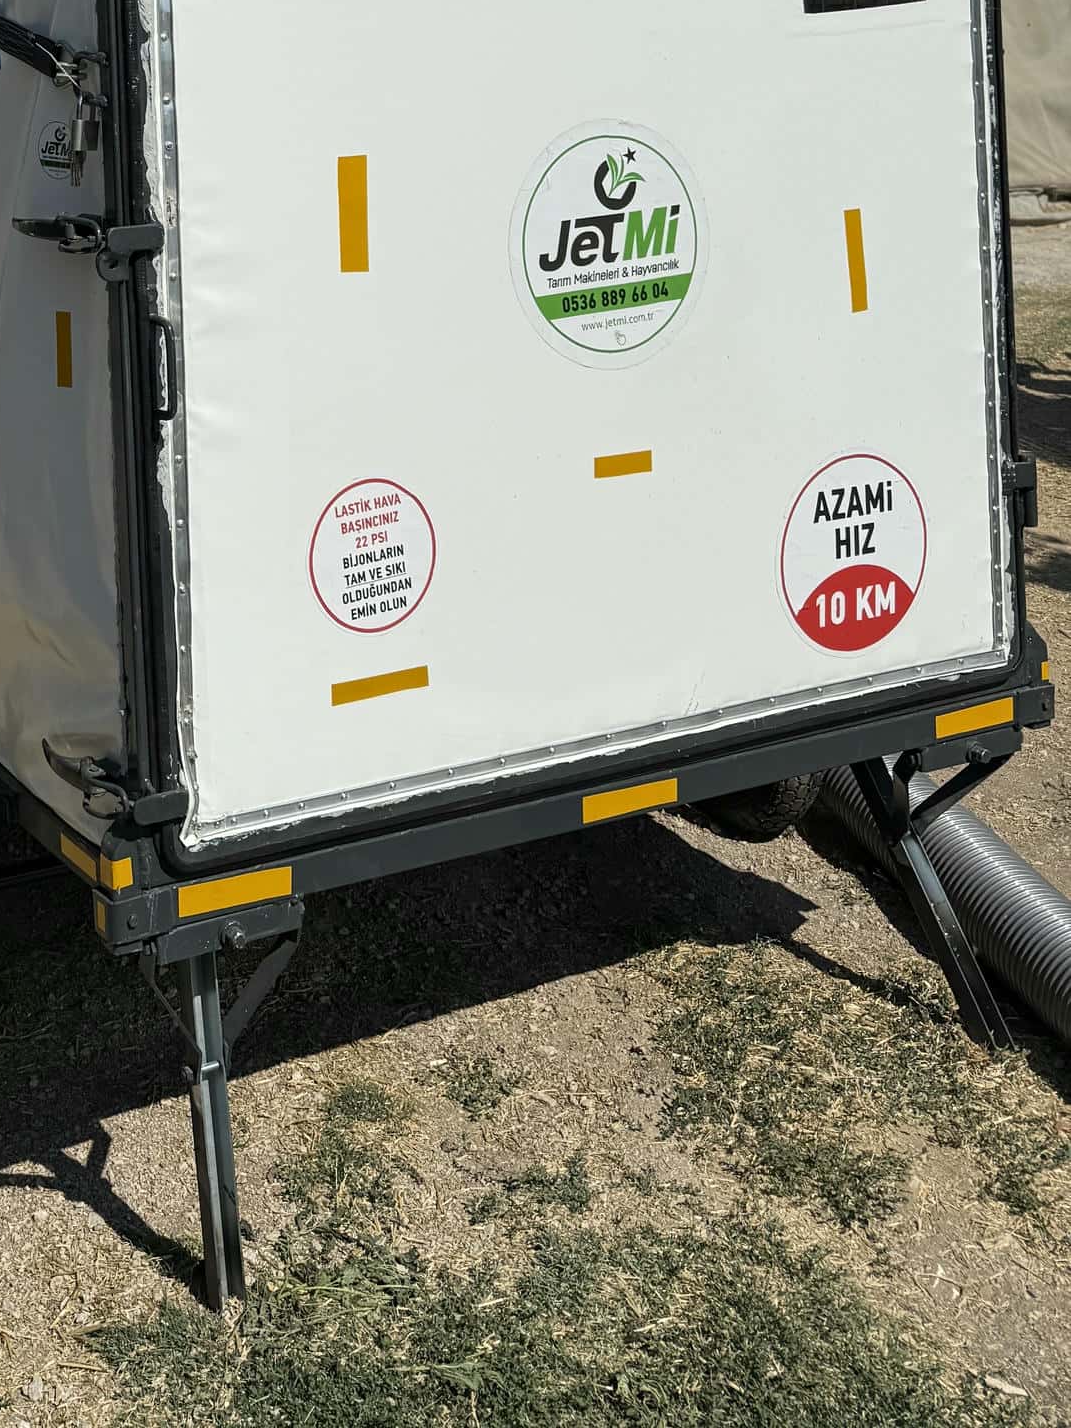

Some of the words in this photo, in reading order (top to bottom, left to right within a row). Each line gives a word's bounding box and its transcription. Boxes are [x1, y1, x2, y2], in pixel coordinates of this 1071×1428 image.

[573, 270, 620, 287] Makineleri
[621, 268, 629, 278] &
[631, 259, 680, 277] Hayvancılık
[562, 292, 597, 313] 0536
[601, 288, 626, 307] 889
[632, 285, 648, 302] 66
[652, 282, 669, 298] 04
[581, 312, 655, 332] www.jetmi.com.tr
[334, 498, 372, 518] LASTİK
[374, 493, 401, 509] HAVA
[340, 511, 399, 535] BAŞINCINIZ
[355, 536, 369, 549] 22
[371, 531, 388, 545] PSI
[835, 522, 876, 559] HIZ
[342, 544, 404, 569] BİJONLARIN
[344, 572, 366, 587] TAM
[369, 567, 382, 580] VE
[385, 561, 406, 577] SIKI
[342, 577, 412, 605] OLDUĞUNDAN
[351, 601, 377, 620] EMİN
[380, 595, 407, 613] OLUN
[815, 590, 846, 628] 10
[856, 580, 896, 621] KM
